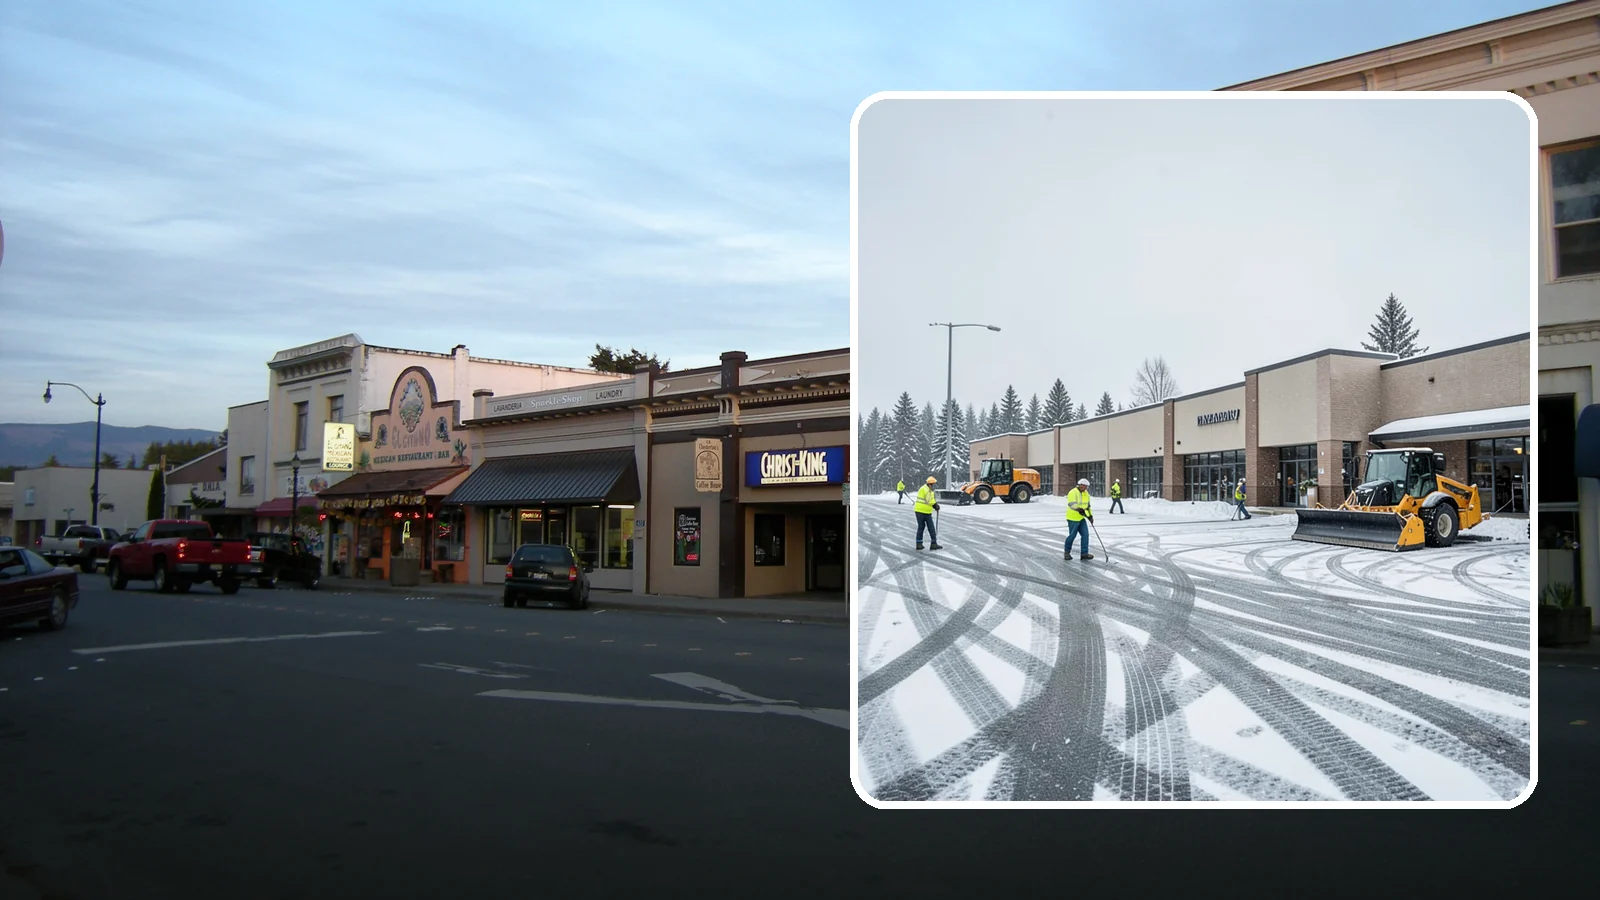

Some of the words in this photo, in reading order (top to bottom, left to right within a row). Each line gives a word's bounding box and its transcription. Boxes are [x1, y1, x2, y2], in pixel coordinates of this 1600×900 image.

[530, 396, 560, 408] Sparkle
[561, 394, 582, 407] Shop
[595, 389, 624, 400] LAUNDRY
[493, 402, 523, 412] LAVANDERIA
[373, 454, 396, 464] MEXICAN
[397, 451, 433, 462] RESTAURANT
[437, 450, 450, 459] BAR
[799, 450, 827, 476] KING
